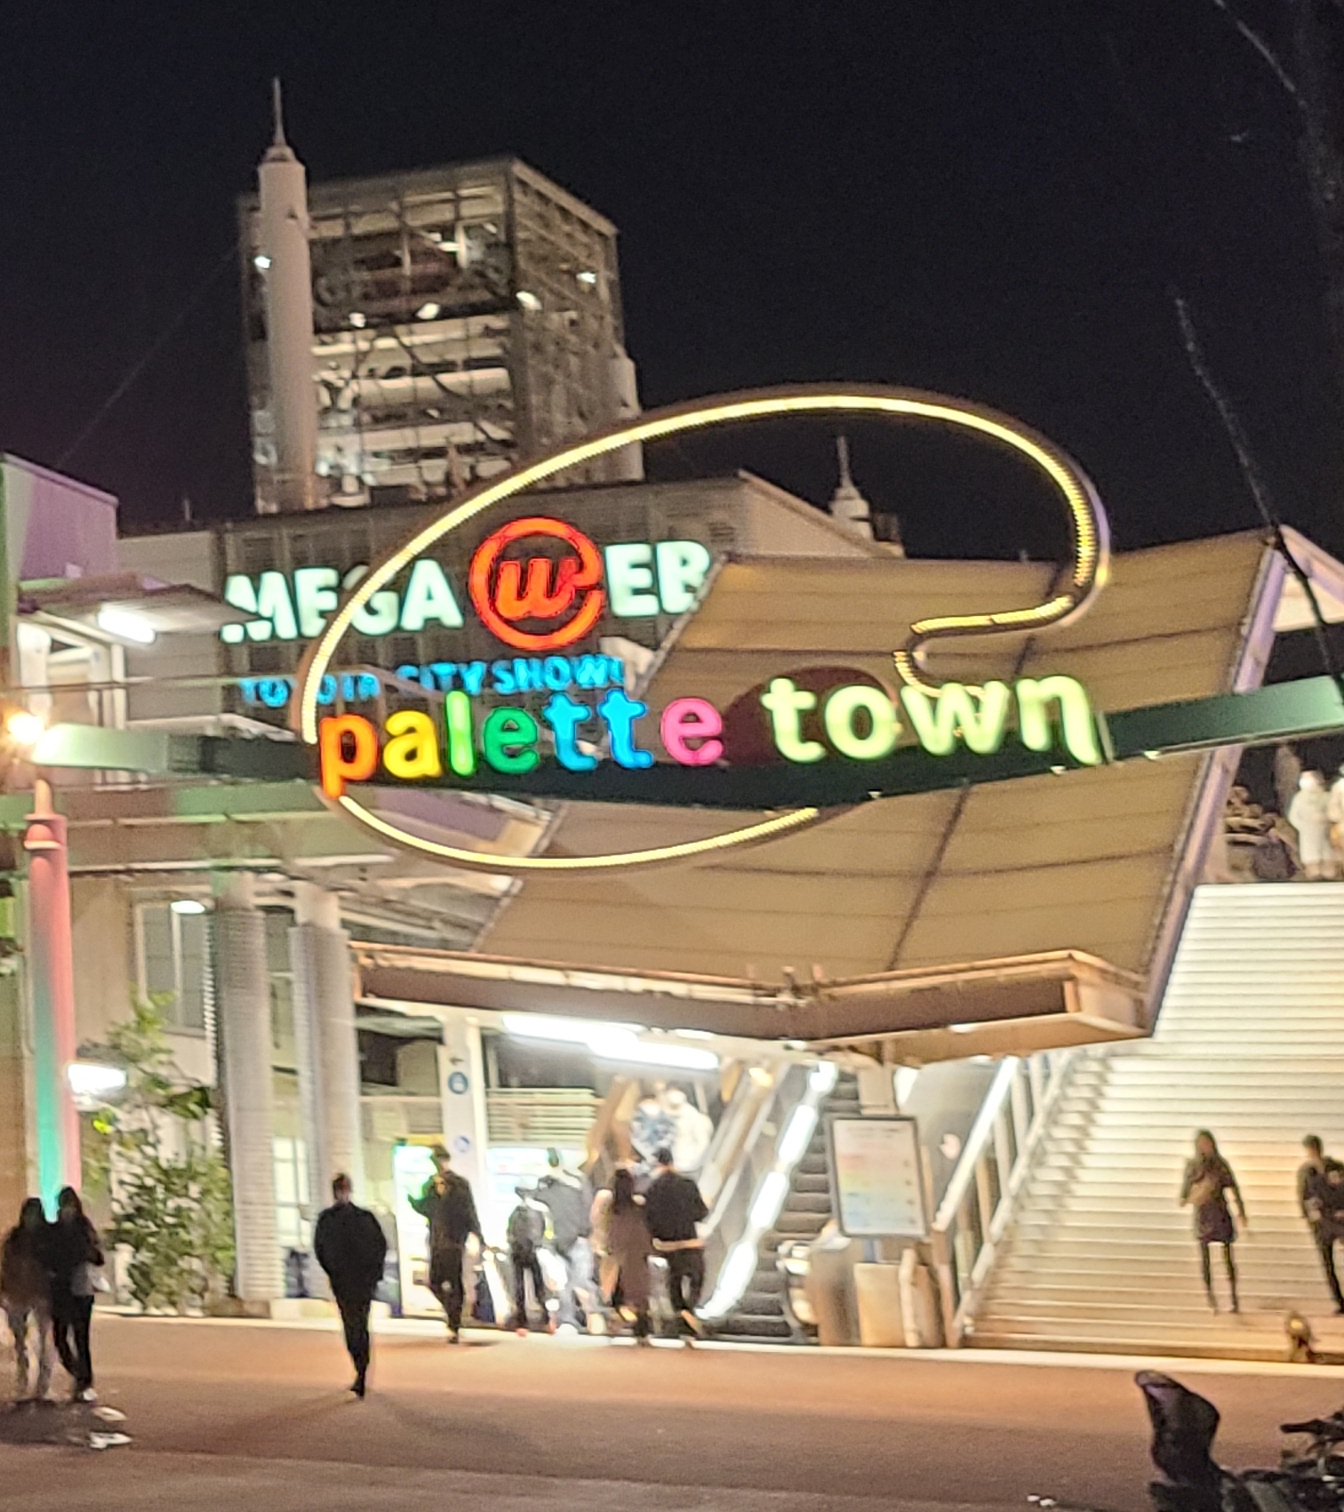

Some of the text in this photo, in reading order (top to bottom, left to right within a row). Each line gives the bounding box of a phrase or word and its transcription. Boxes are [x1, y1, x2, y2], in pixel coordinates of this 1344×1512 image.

[220, 558, 464, 643] MEGA
[319, 676, 1100, 800] palette town
